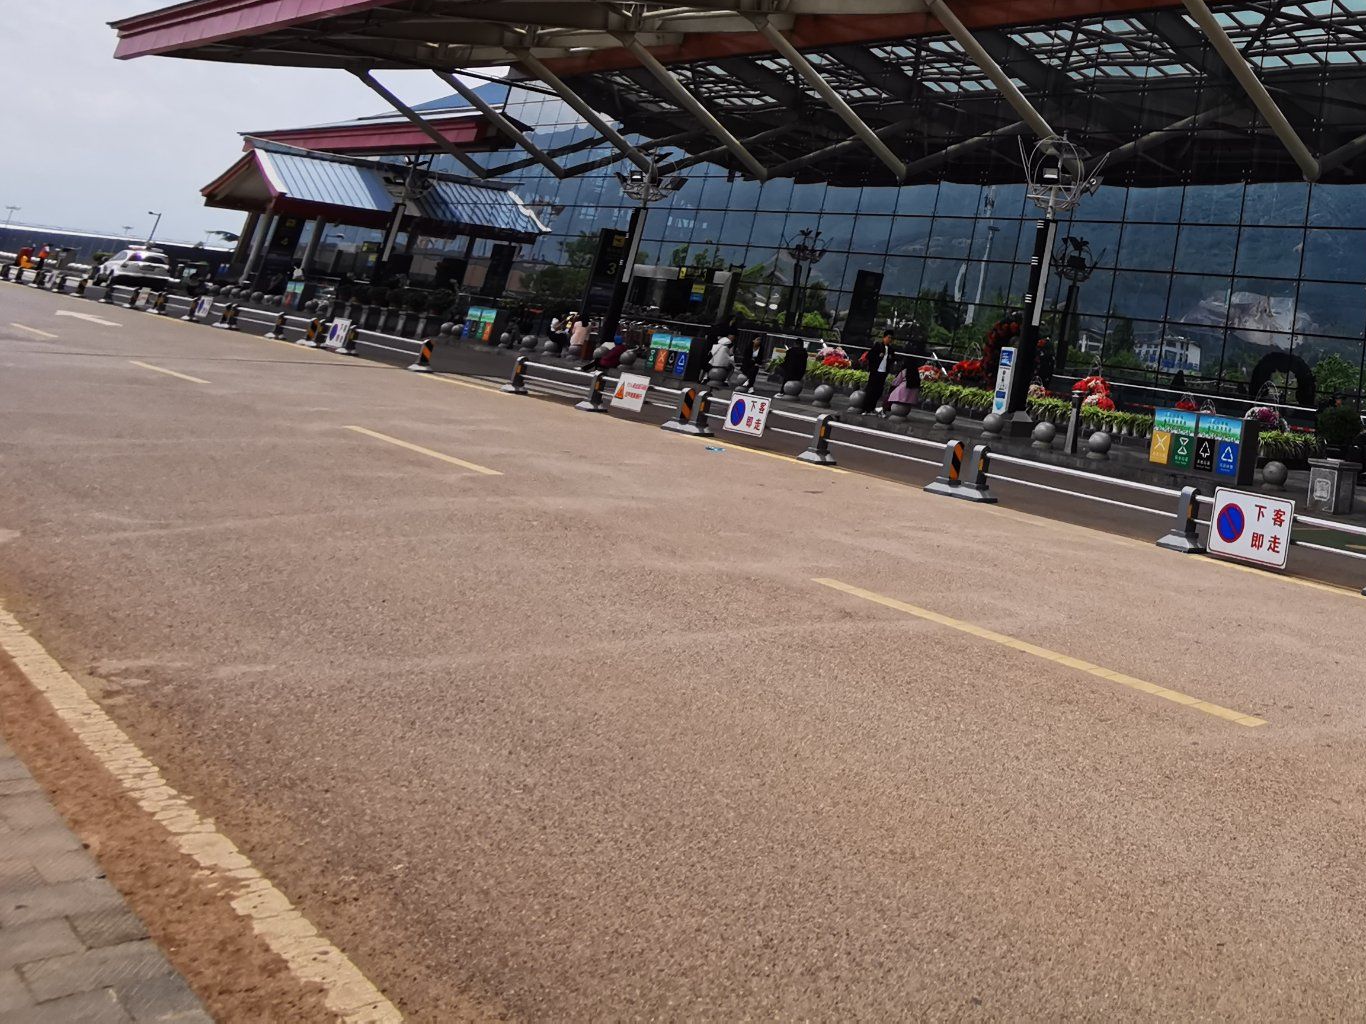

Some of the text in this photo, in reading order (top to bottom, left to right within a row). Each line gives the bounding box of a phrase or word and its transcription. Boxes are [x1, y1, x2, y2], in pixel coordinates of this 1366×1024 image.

[751, 401, 766, 414] 下客
[1254, 504, 1286, 527] 下客
[1250, 532, 1281, 554] 即走
